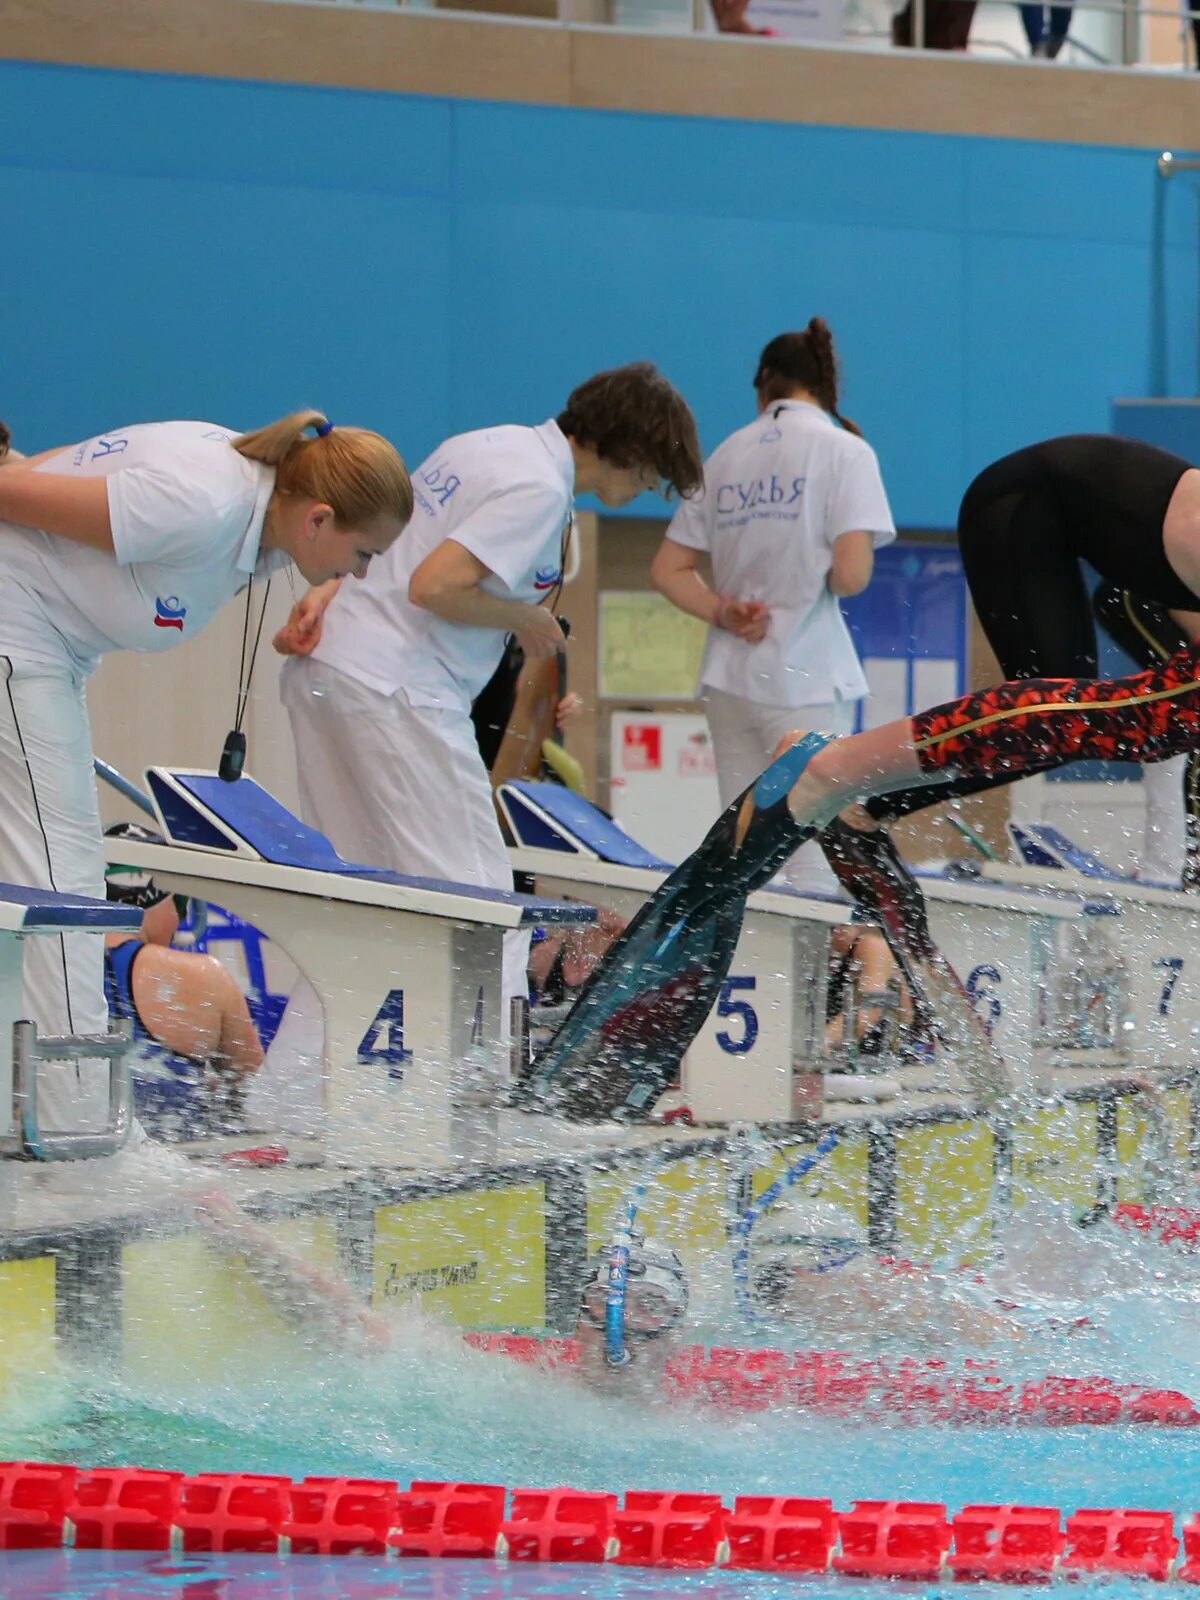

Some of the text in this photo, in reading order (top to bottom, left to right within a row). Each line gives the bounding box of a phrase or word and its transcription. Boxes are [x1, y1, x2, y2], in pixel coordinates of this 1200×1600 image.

[715, 975, 759, 1055] 5
[966, 964, 1001, 1036] 6
[1152, 957, 1184, 1015] 7
[357, 989, 413, 1080] 4
